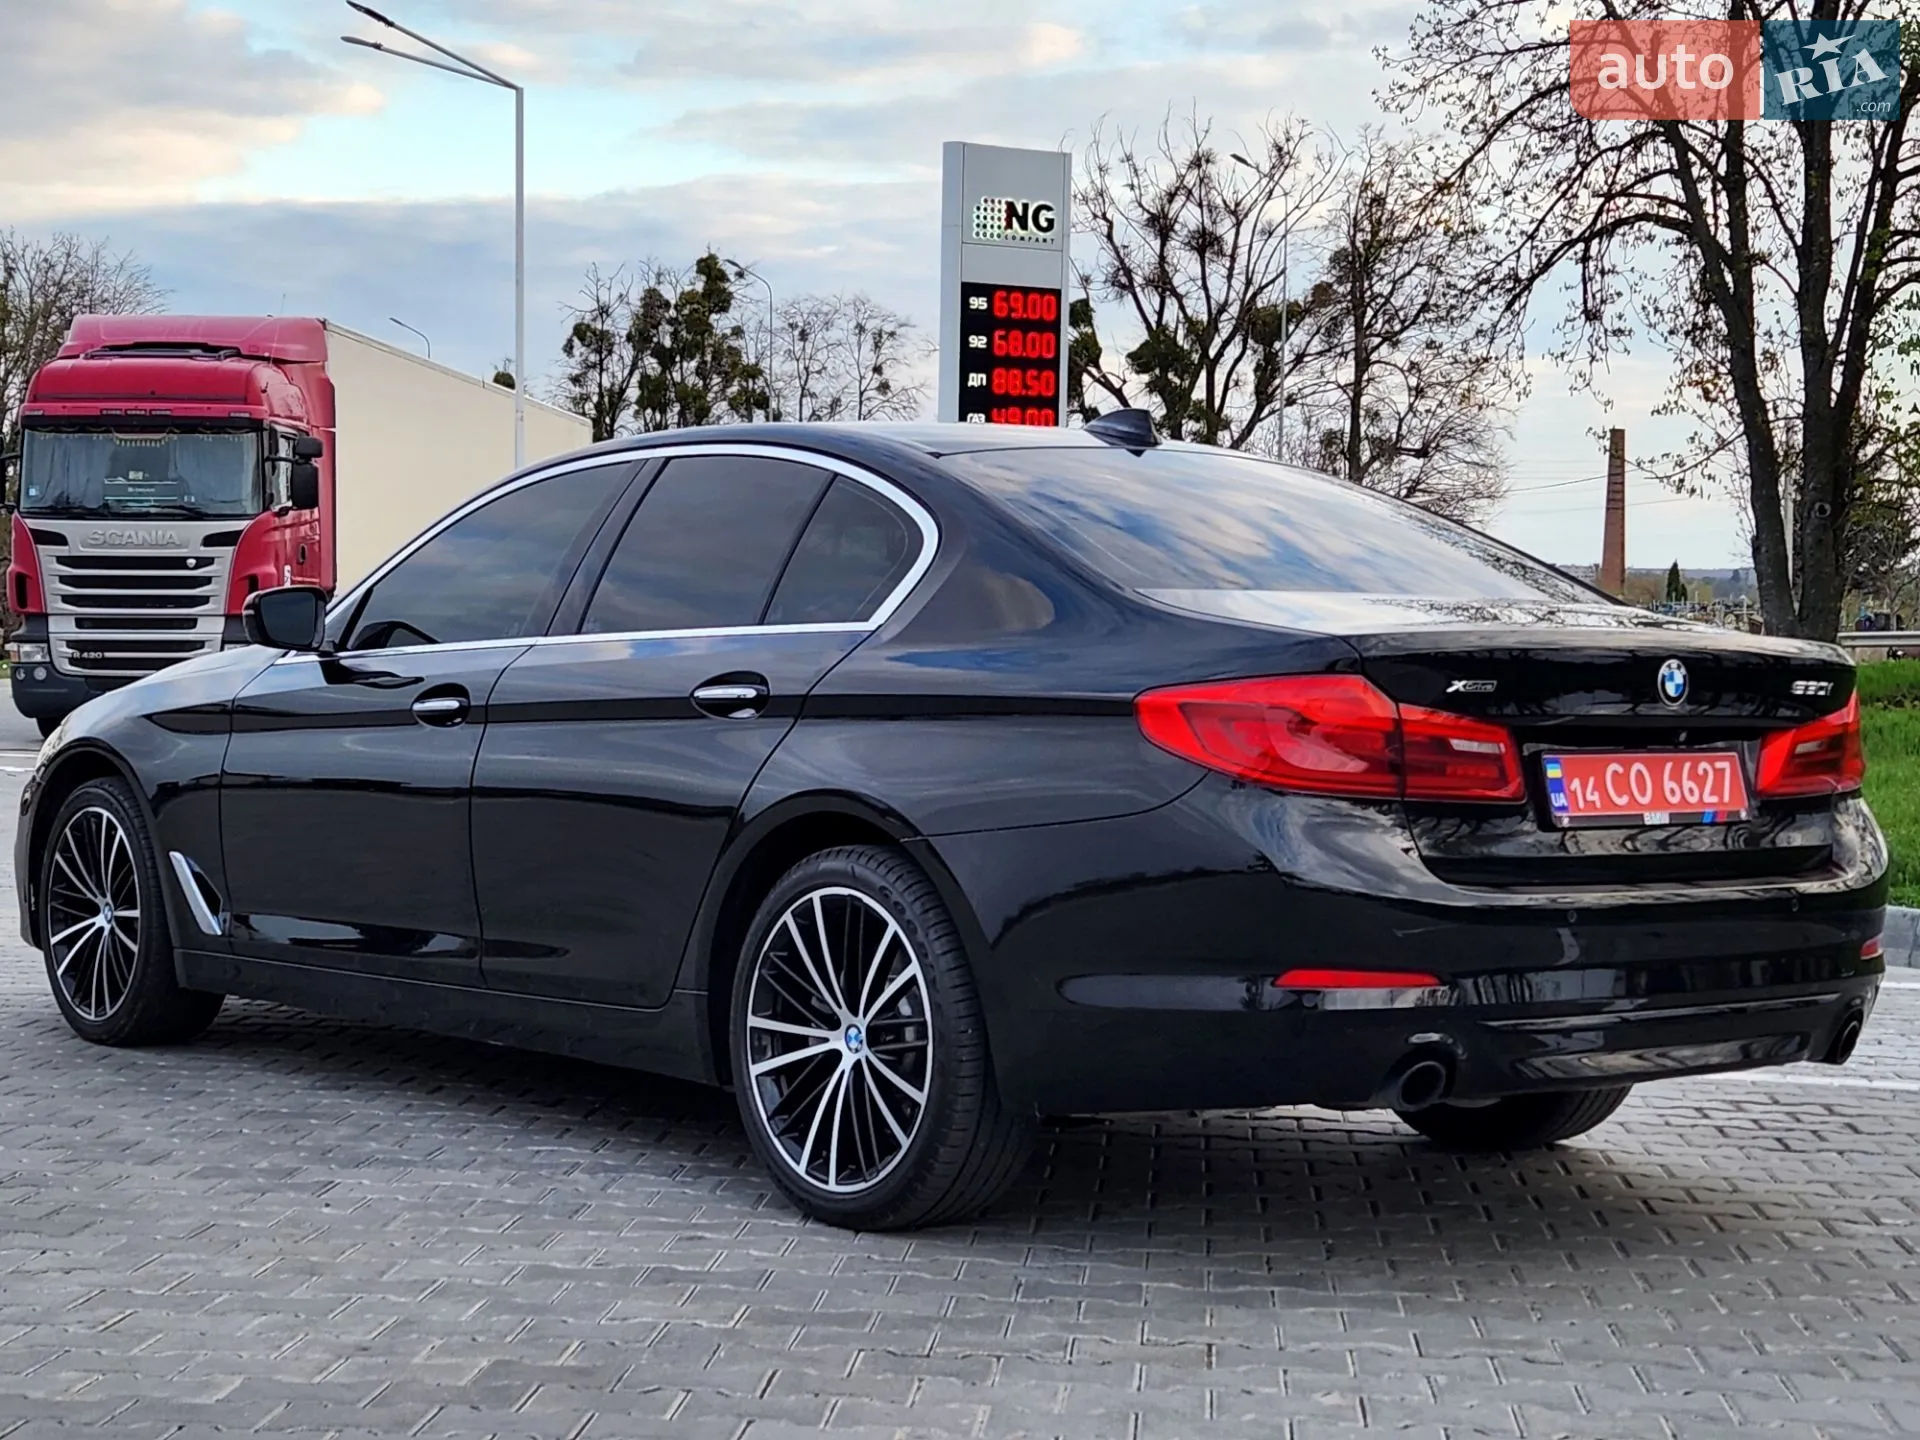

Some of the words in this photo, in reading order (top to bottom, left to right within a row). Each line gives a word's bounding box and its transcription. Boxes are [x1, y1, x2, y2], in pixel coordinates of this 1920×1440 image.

[968, 296, 988, 310] 95
[993, 290, 1057, 321] 69.00
[968, 334, 988, 349] 92
[993, 329, 1056, 359] 68.00
[967, 372, 987, 388] ДП
[992, 367, 1056, 397] 88.50
[967, 412, 986, 424] ГАЗ
[991, 406, 1056, 427] 4900
[87, 530, 182, 546] SCANIA
[1551, 793, 1568, 807] UA
[1569, 767, 1602, 810] 14
[1605, 761, 1653, 806] CO
[1663, 760, 1732, 805] 6627
